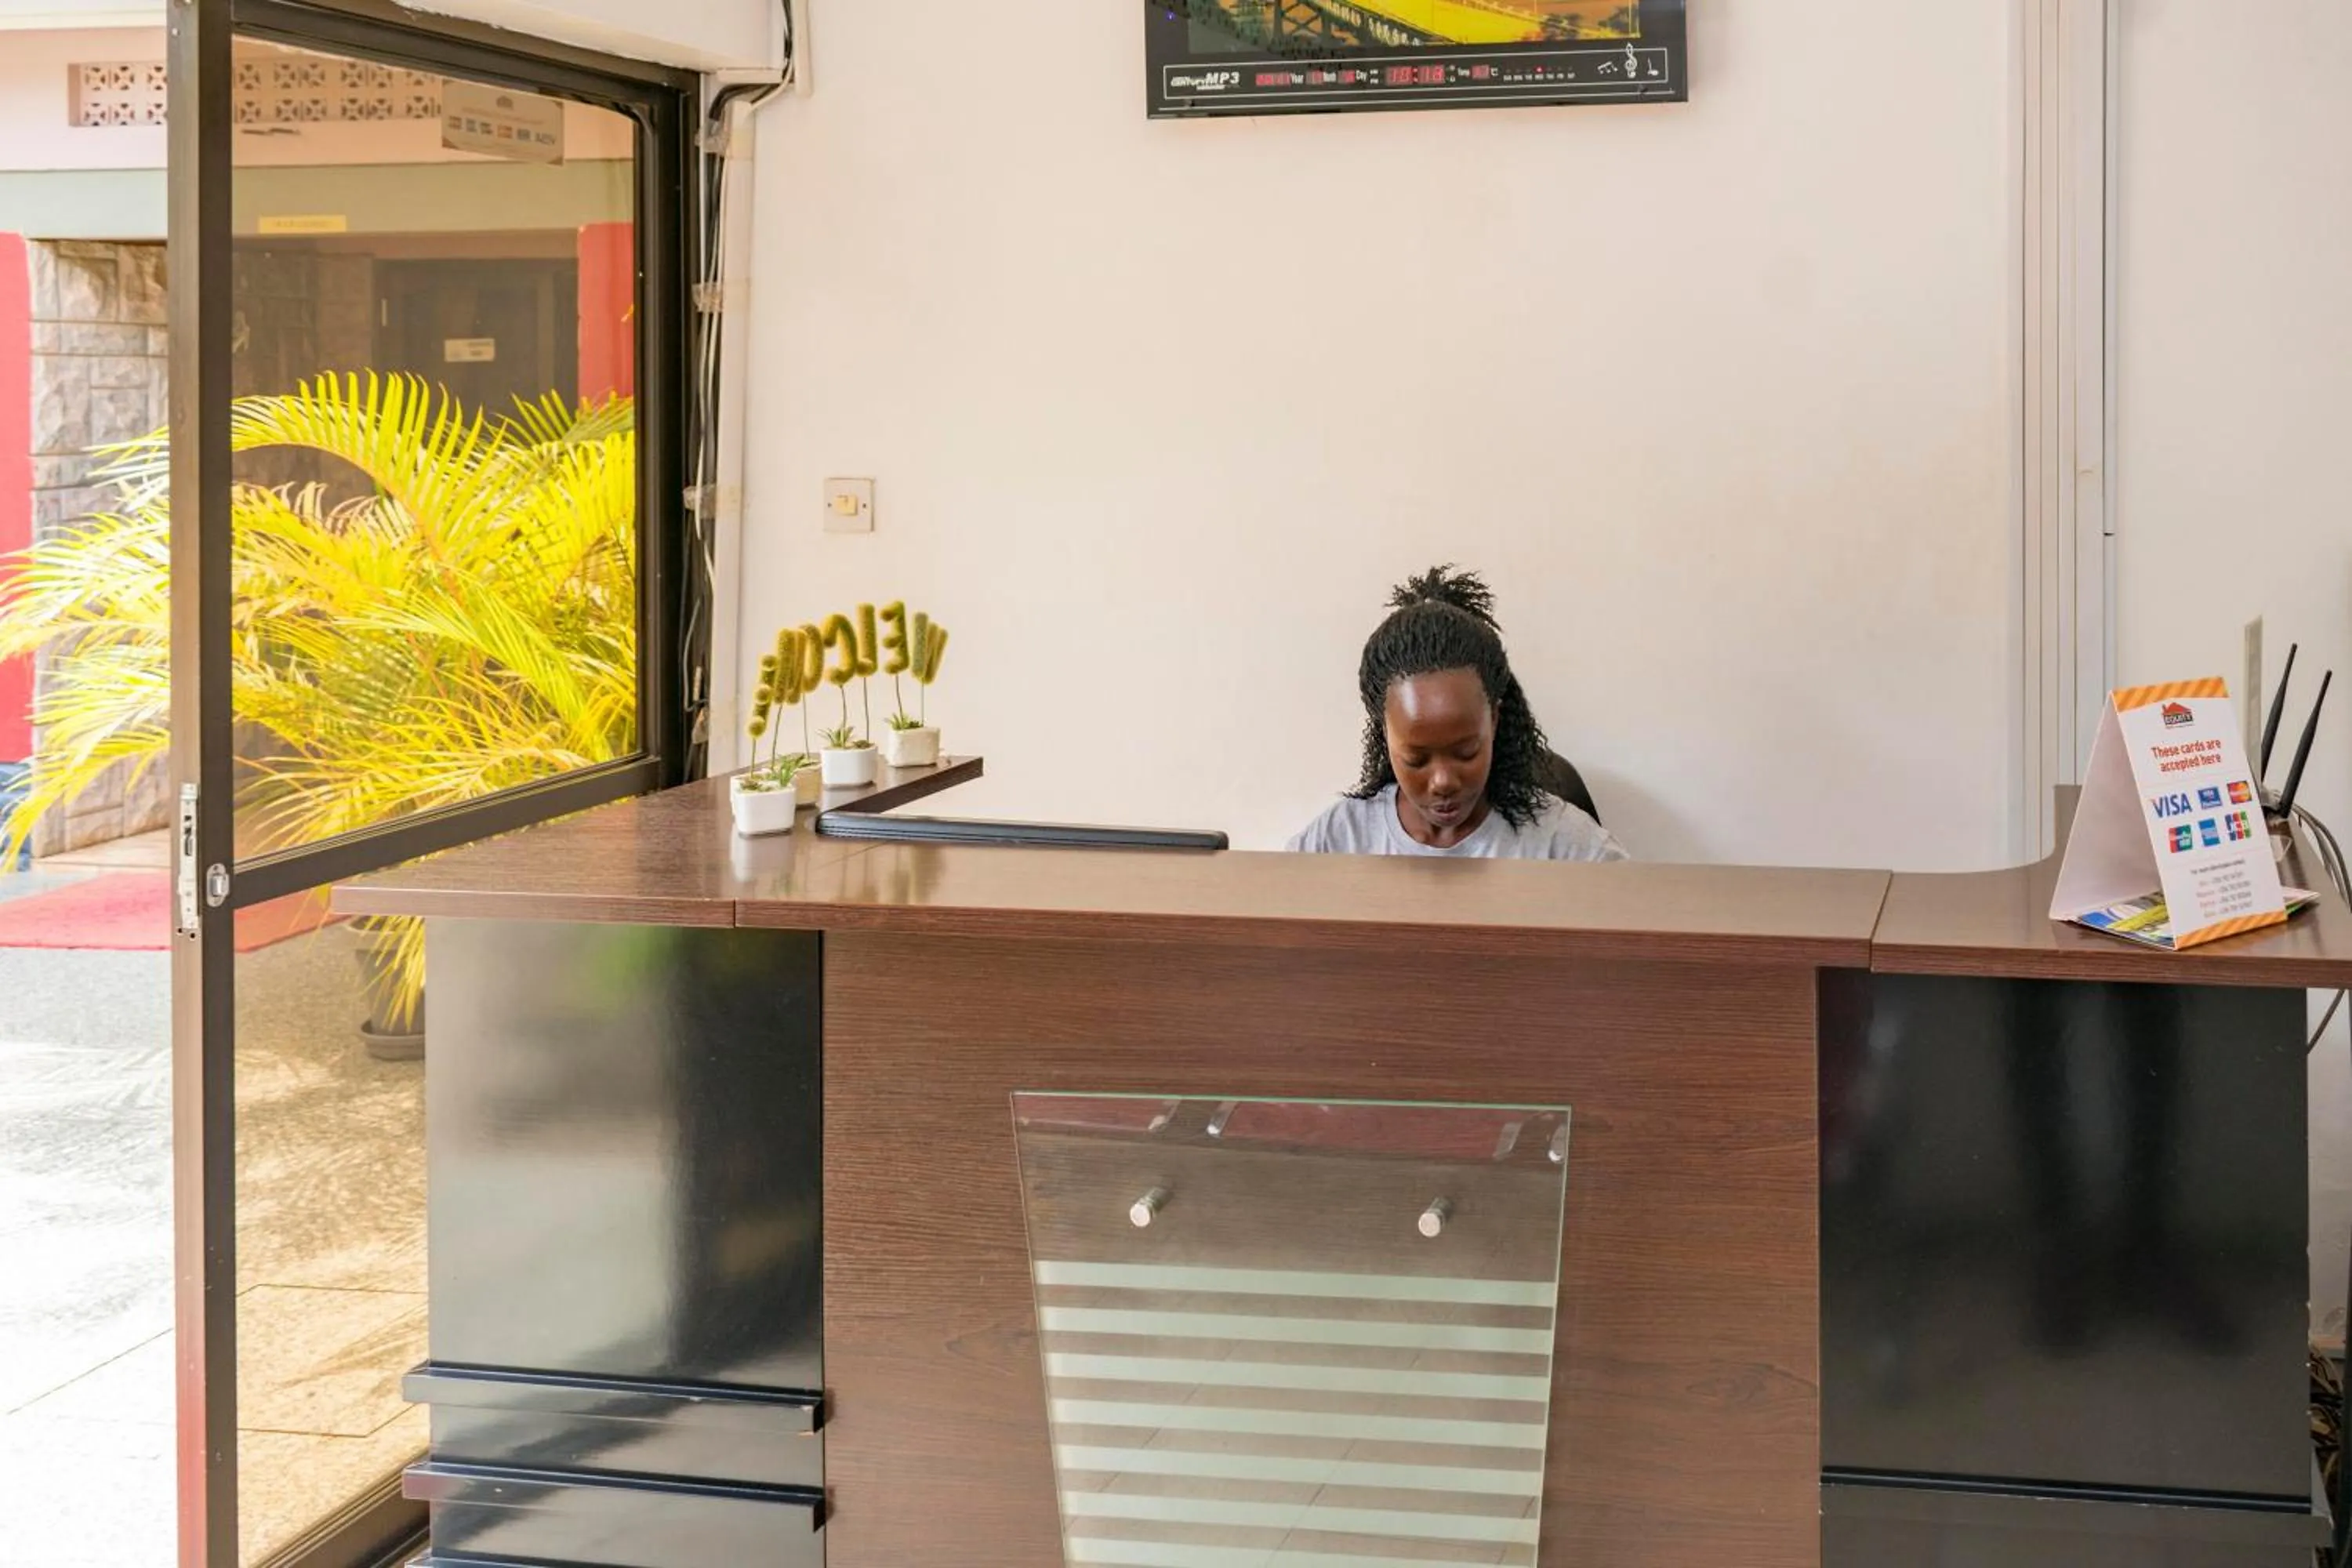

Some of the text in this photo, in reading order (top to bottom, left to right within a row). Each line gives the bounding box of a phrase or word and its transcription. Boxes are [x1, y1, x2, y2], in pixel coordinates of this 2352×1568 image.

[2151, 739, 2221, 759] These cards are
[2160, 753, 2221, 772] accepted here
[2151, 793, 2193, 818] VISA
